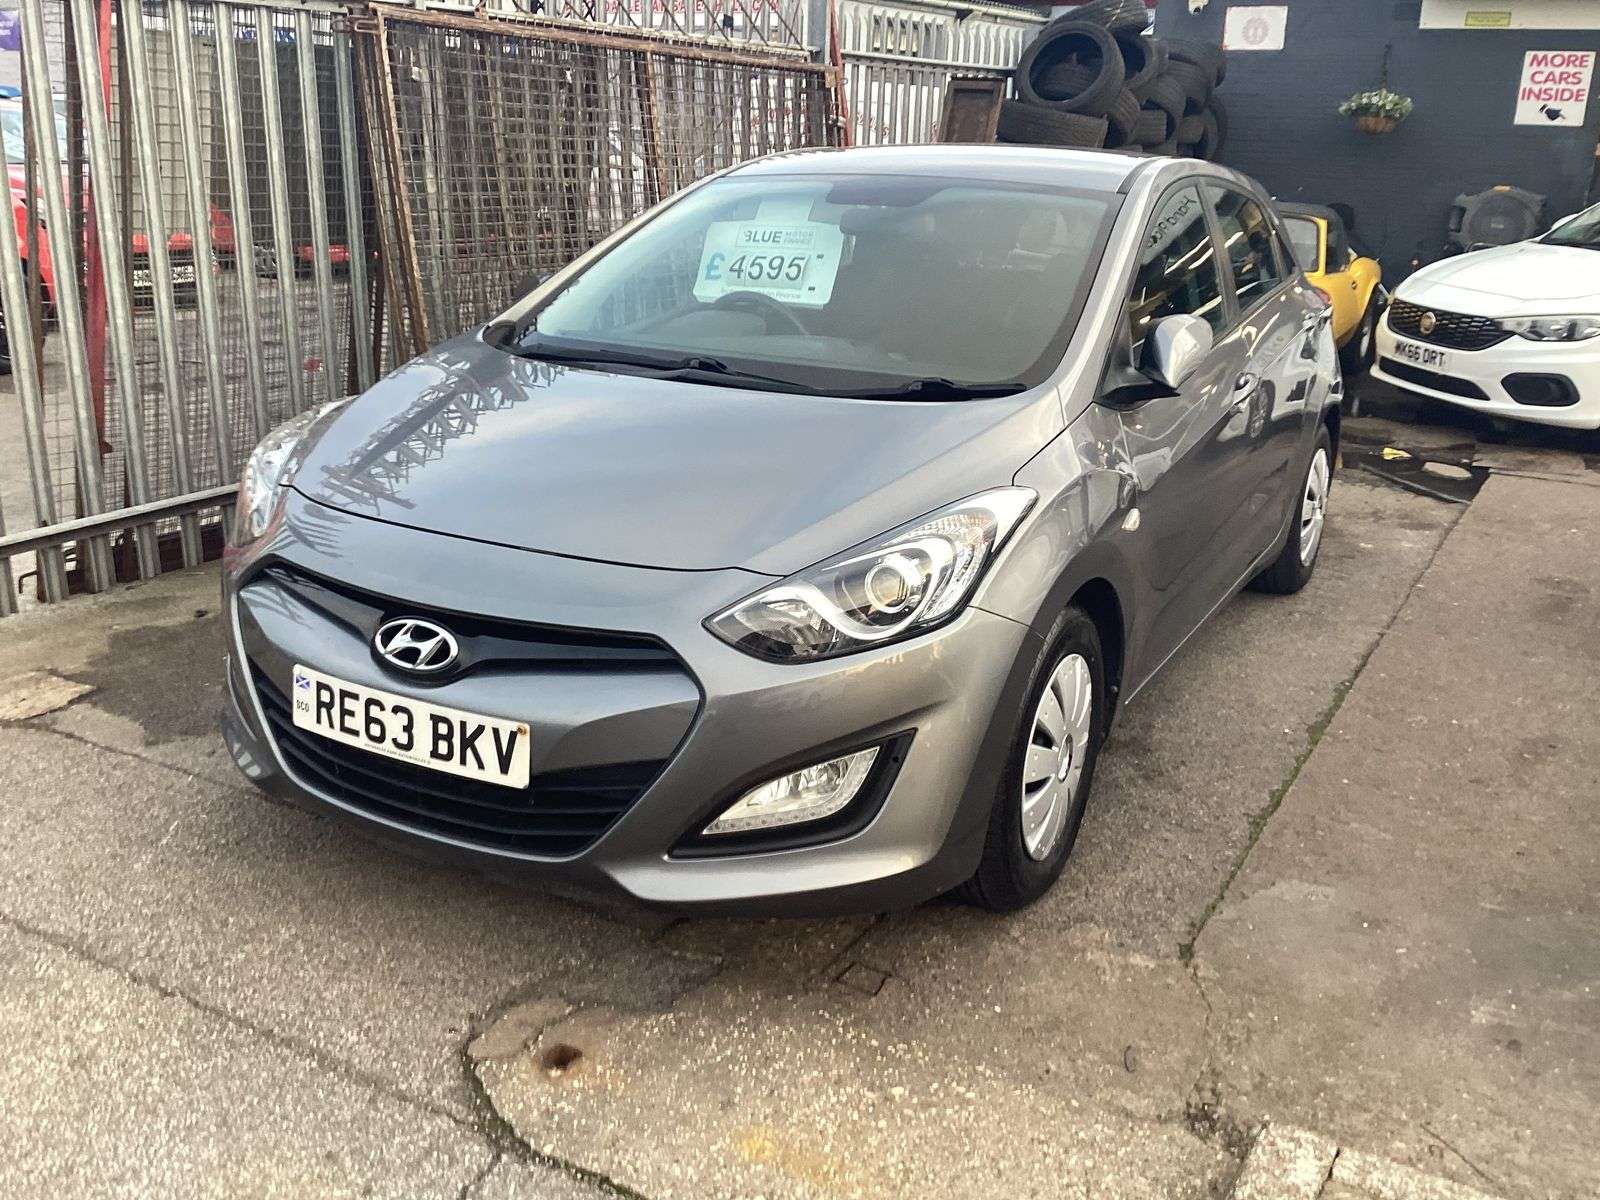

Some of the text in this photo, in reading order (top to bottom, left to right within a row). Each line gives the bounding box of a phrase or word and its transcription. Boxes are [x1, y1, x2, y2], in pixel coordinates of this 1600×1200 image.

[1529, 53, 1590, 68] MORE
[1530, 70, 1583, 85] CARS
[1521, 87, 1586, 102] INSIDE
[316, 680, 517, 775] RE63 BKV
